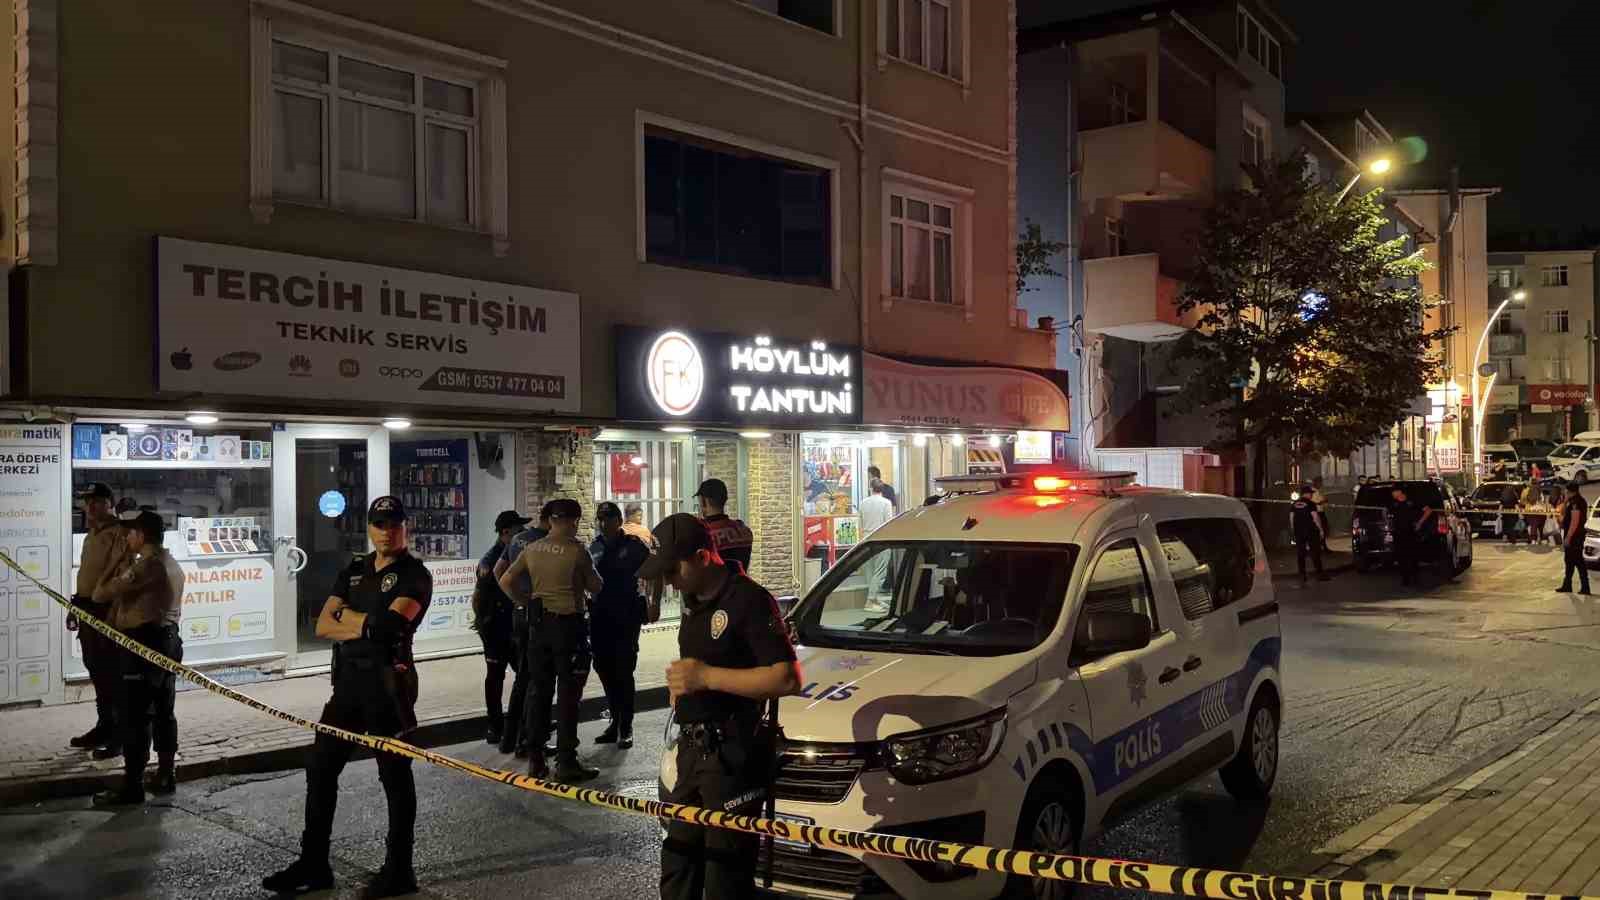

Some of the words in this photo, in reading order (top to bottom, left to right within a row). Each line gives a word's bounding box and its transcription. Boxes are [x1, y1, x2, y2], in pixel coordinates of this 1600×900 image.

[183, 263, 363, 313] TERCİH
[379, 279, 547, 336] İLETİŞİM
[276, 321, 375, 346] TEKNİK
[385, 332, 469, 354] SERVİS
[474, 374, 501, 390] 0537
[507, 377, 528, 391] 477
[531, 379, 544, 393] 04
[547, 380, 561, 393] 04
[730, 382, 852, 414] TANTUNİ
[867, 374, 987, 415] YUNUS
[17, 452, 59, 464] ÖDEME
[182, 567, 263, 585] NLARINIZ
[181, 589, 236, 605] ATILIR
[799, 681, 860, 701] LİS
[1113, 717, 1162, 776] POLİS
[1028, 853, 1151, 890] POLİS
